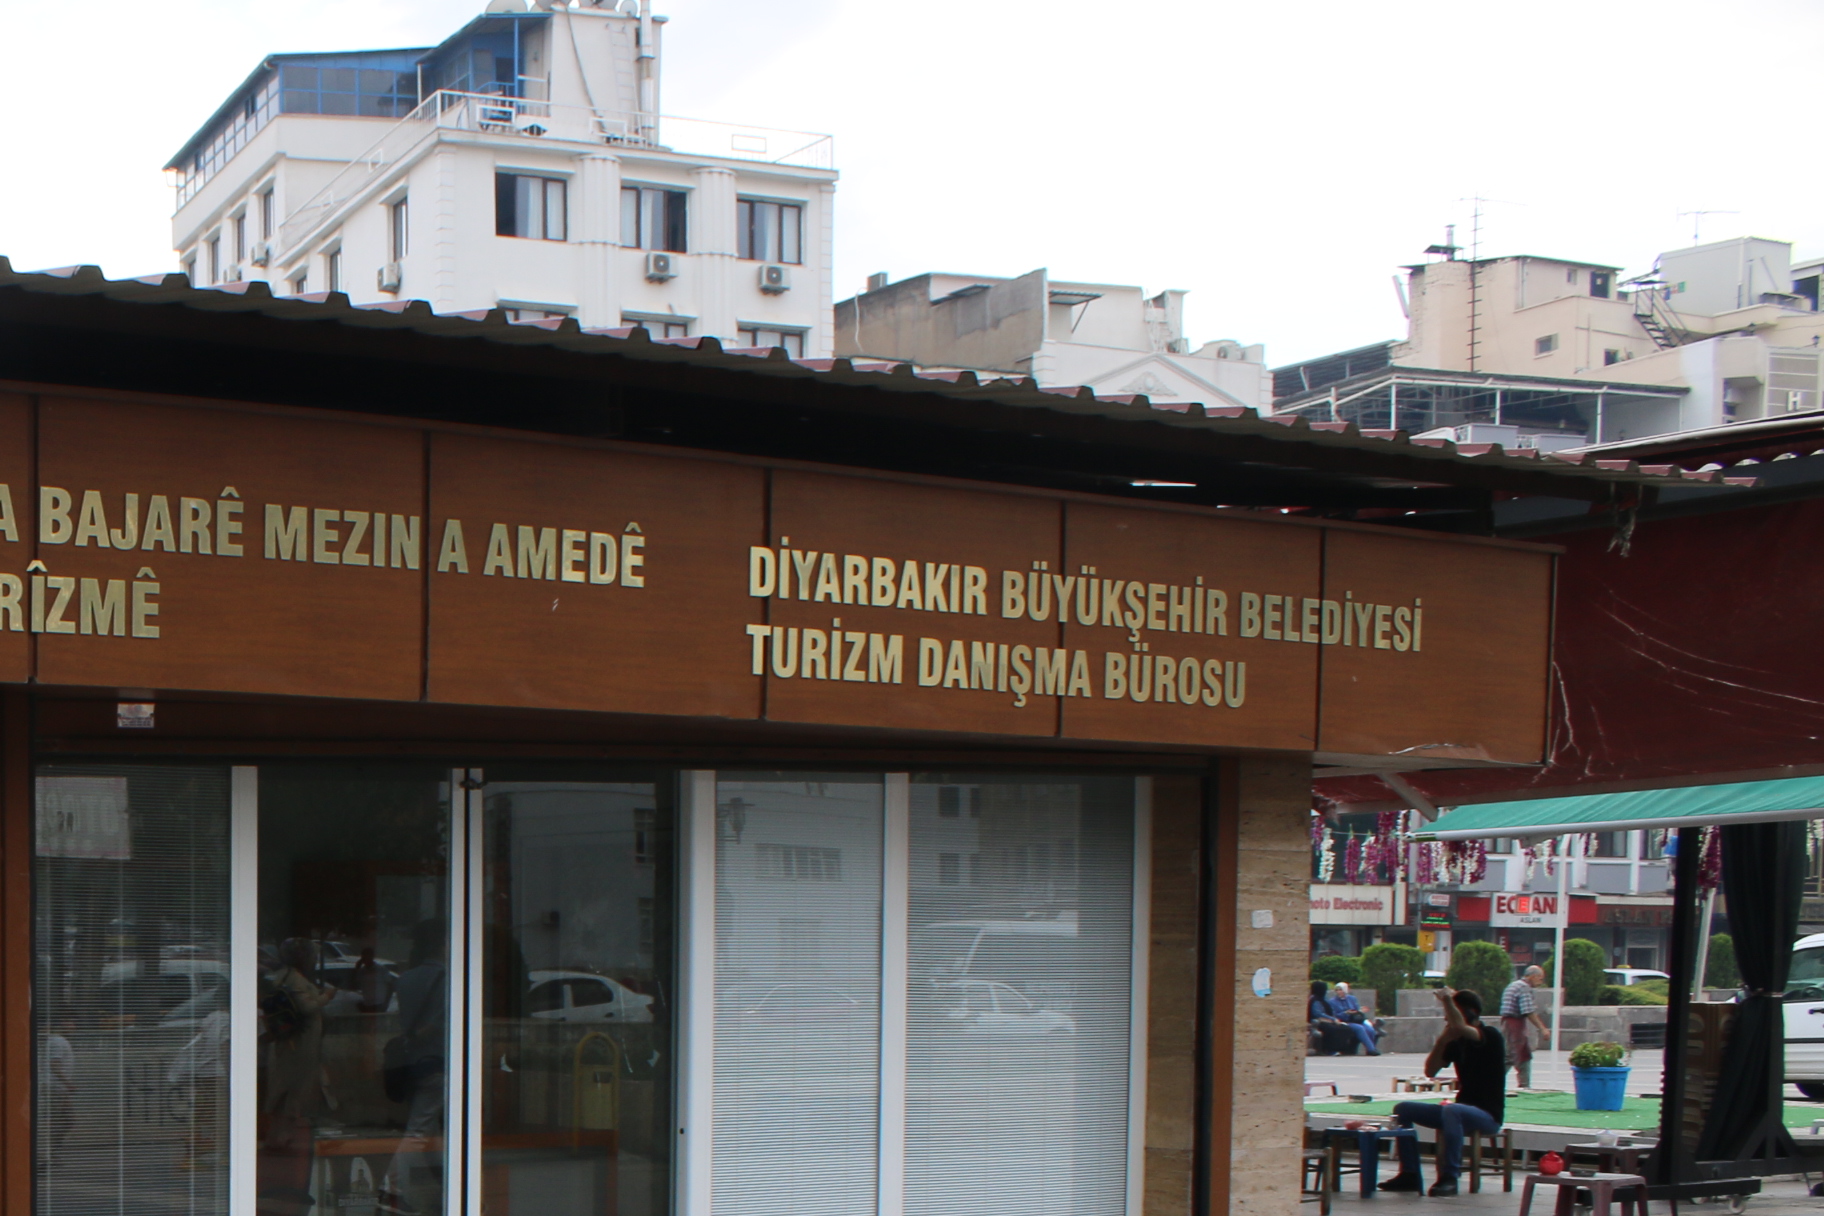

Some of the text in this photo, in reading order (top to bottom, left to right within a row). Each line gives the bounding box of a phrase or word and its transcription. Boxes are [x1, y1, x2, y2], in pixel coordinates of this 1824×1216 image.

[39, 486, 244, 558] BAJARÊ
[264, 503, 421, 570] MEZIN
[436, 518, 469, 574] A
[483, 521, 646, 588] AMEDÊ
[749, 536, 1423, 653] DİYARBAKIR BÜYÜKŞEHİR BELEDİYESİ
[746, 617, 1247, 709] TURİZM DANIŞMA BÜROSU
[1333, 897, 1384, 911] Electronic
